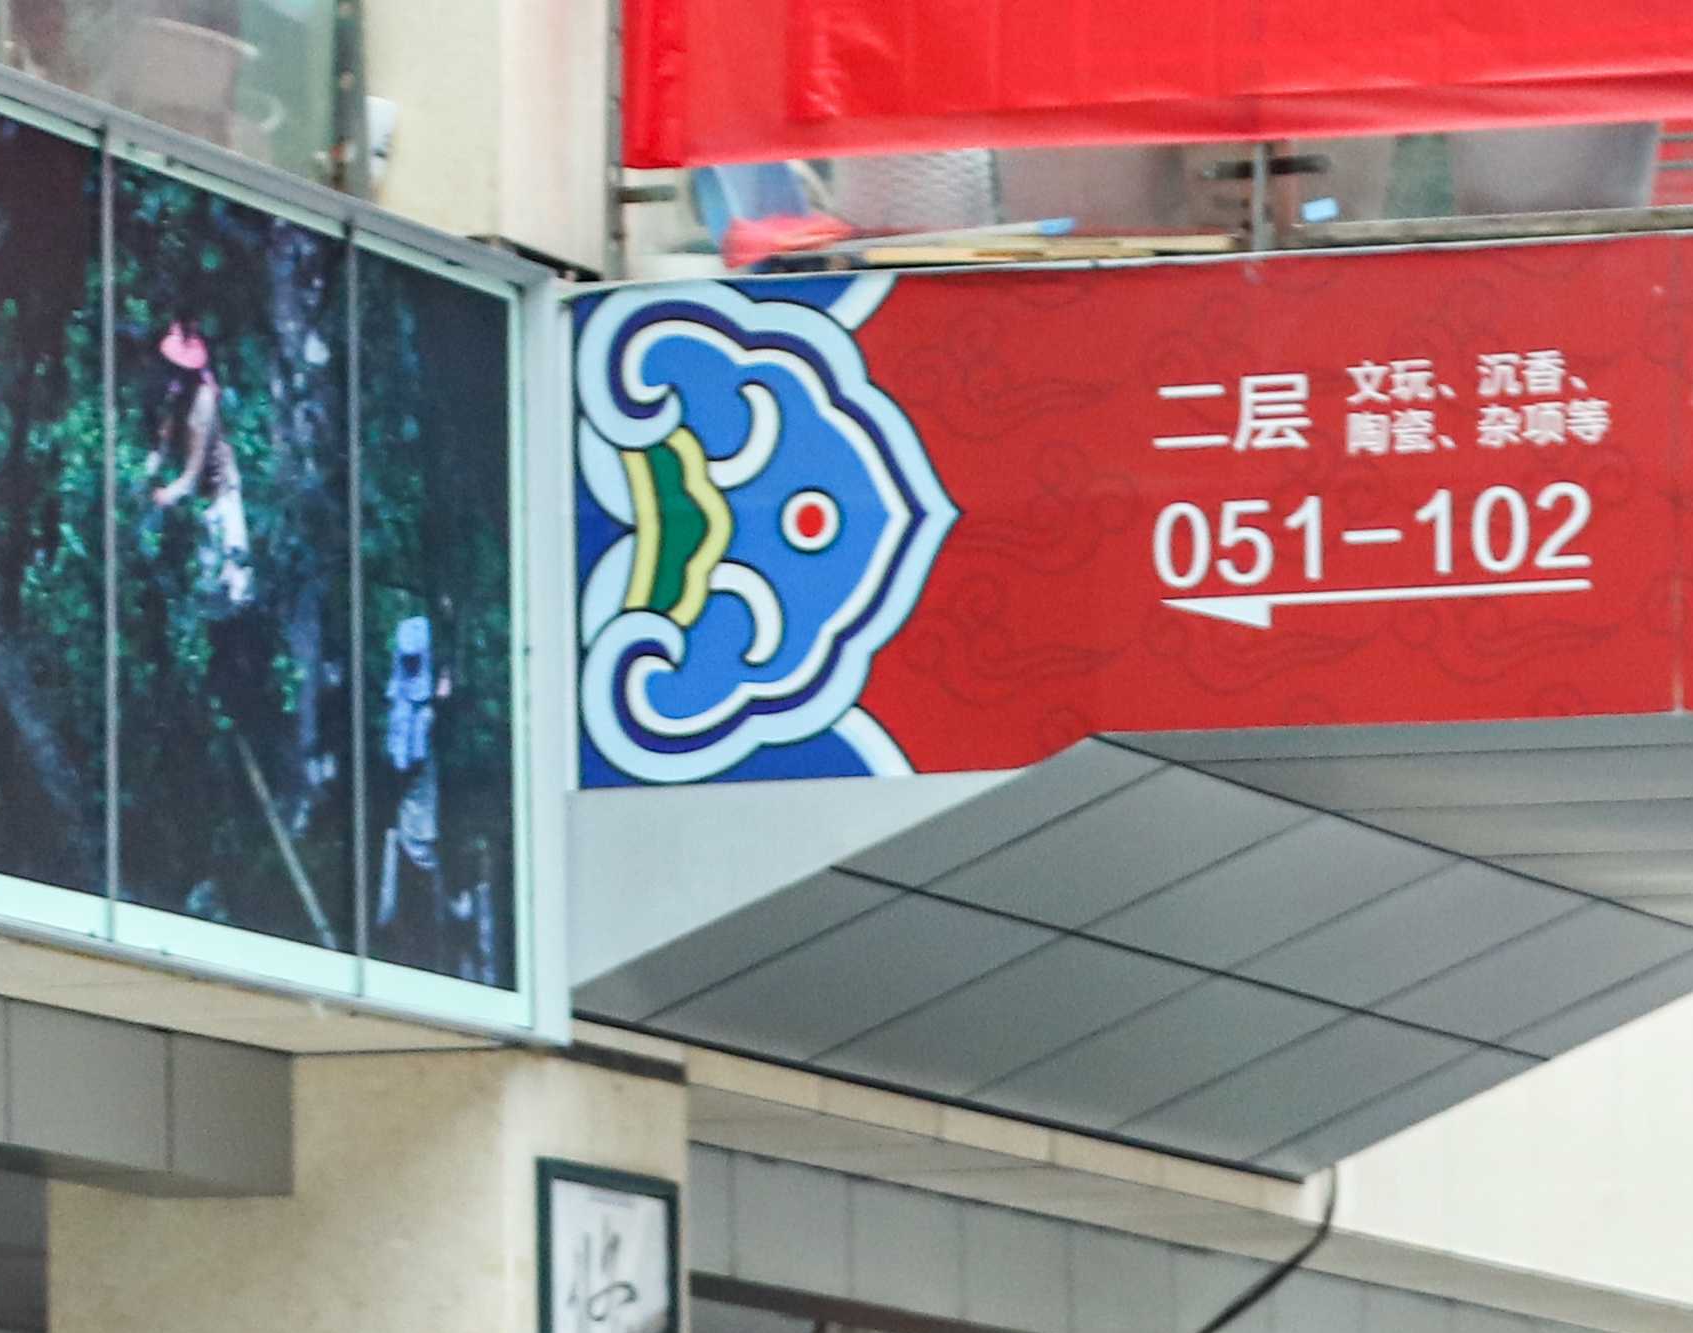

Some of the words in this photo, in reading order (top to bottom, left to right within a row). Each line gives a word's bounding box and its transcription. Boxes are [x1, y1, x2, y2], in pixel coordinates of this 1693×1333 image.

[1152, 373, 1313, 452] 二层
[1345, 399, 1612, 456] 陶瓷、杂项等
